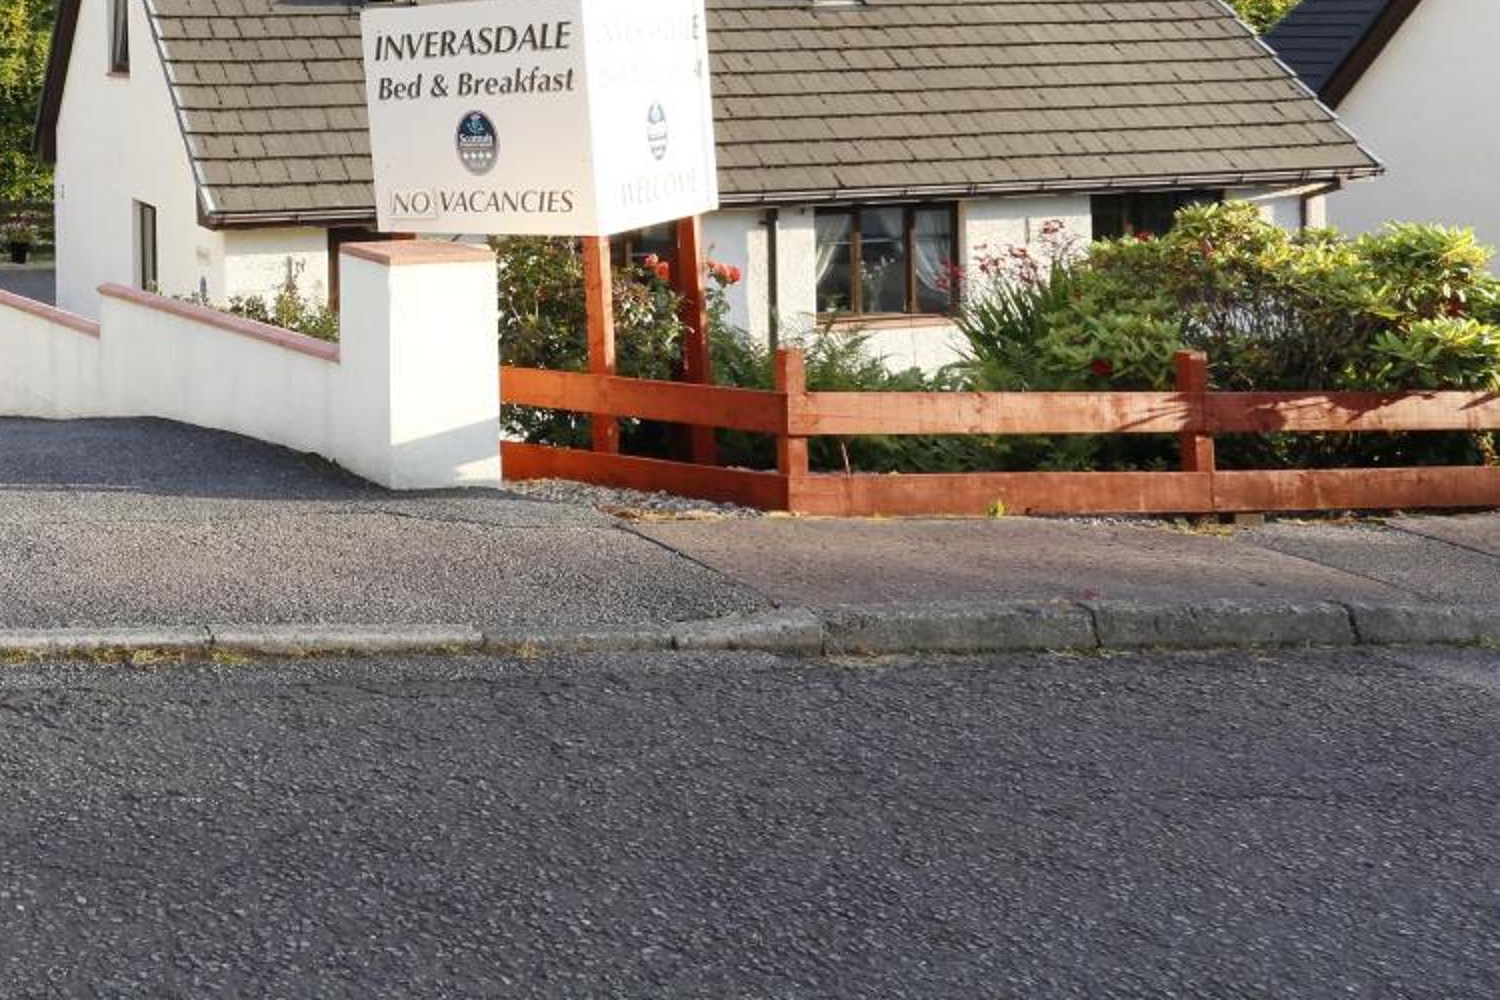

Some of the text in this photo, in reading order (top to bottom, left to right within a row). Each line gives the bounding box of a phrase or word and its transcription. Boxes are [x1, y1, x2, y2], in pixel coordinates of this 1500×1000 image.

[375, 21, 572, 61] INVERASDALE
[378, 73, 422, 100] Bed
[430, 73, 449, 98] &
[458, 66, 574, 96] Breakfast
[393, 189, 574, 214] NO VACANCIES
